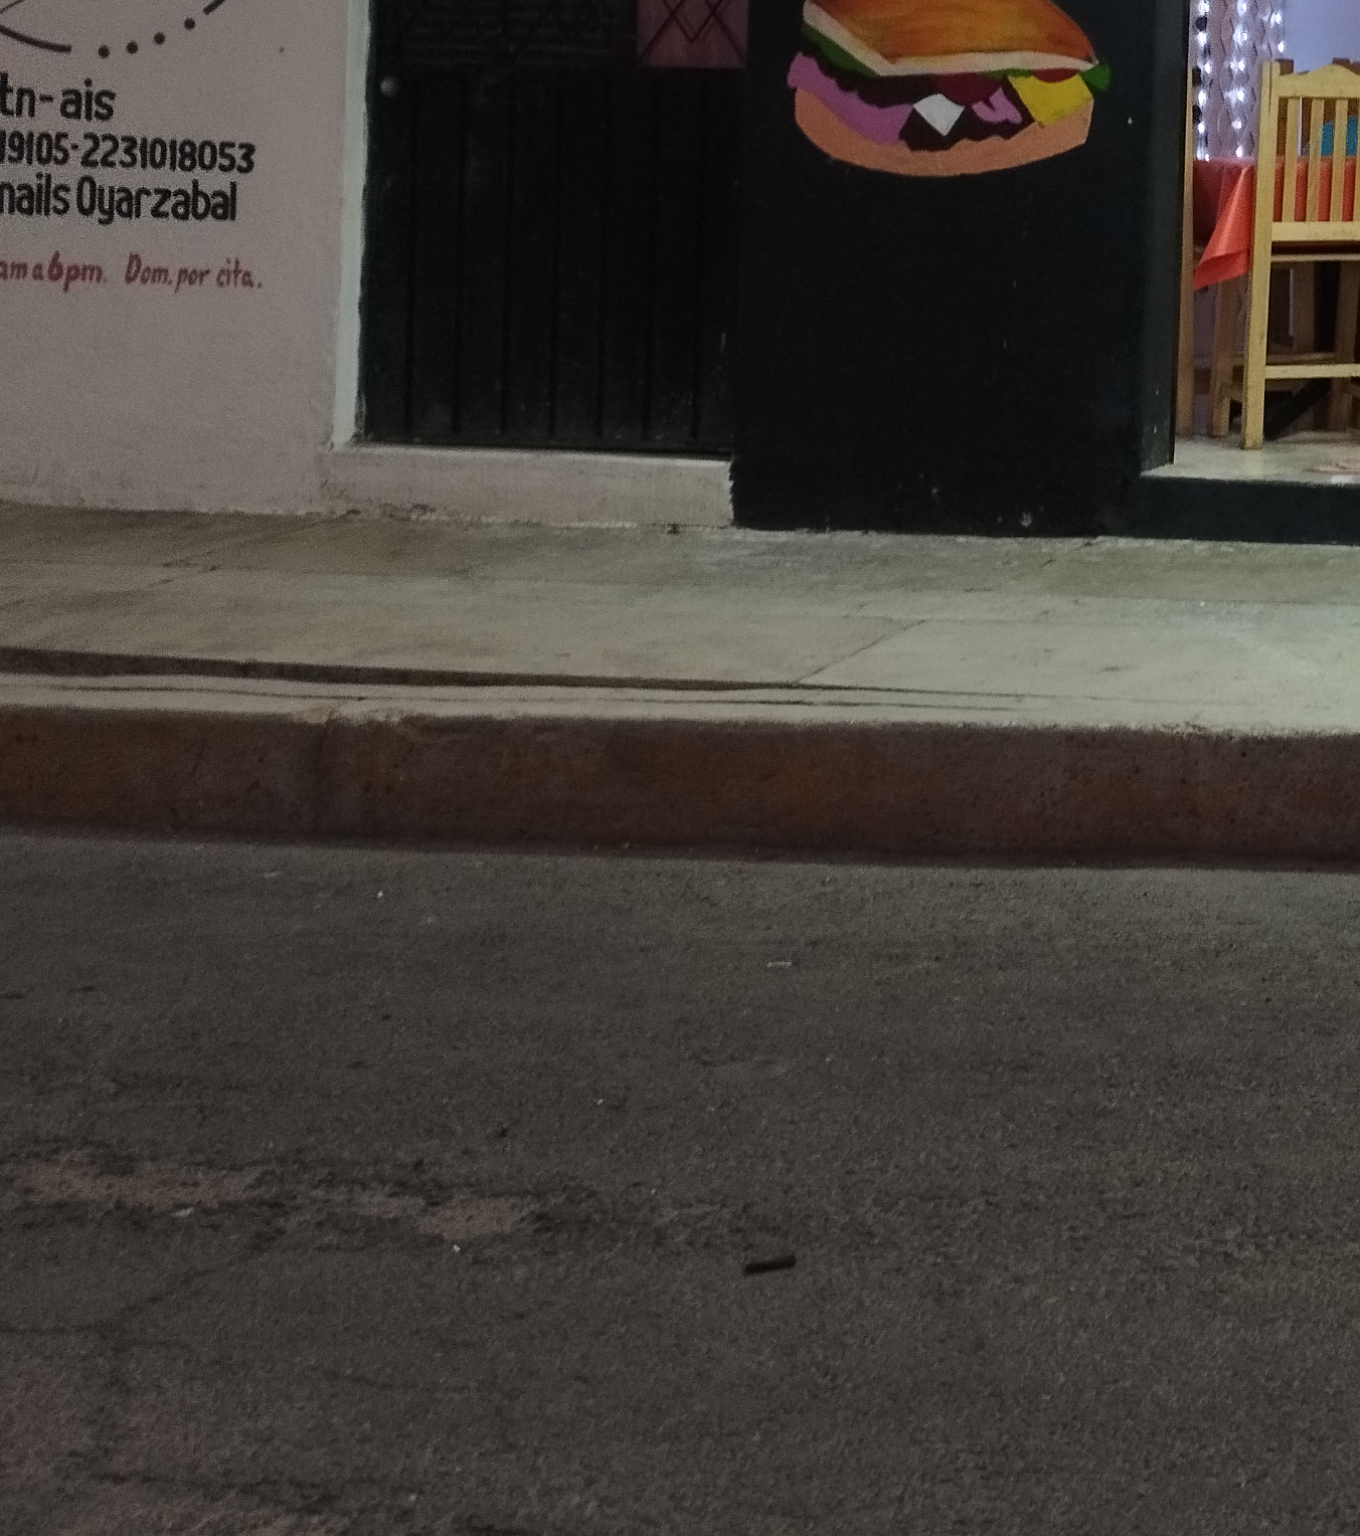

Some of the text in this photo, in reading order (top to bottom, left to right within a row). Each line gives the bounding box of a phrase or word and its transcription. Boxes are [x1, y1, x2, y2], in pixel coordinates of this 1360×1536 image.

[0, 171, 238, 225] nails Oyarzabal
[174, 265, 211, 293] por
